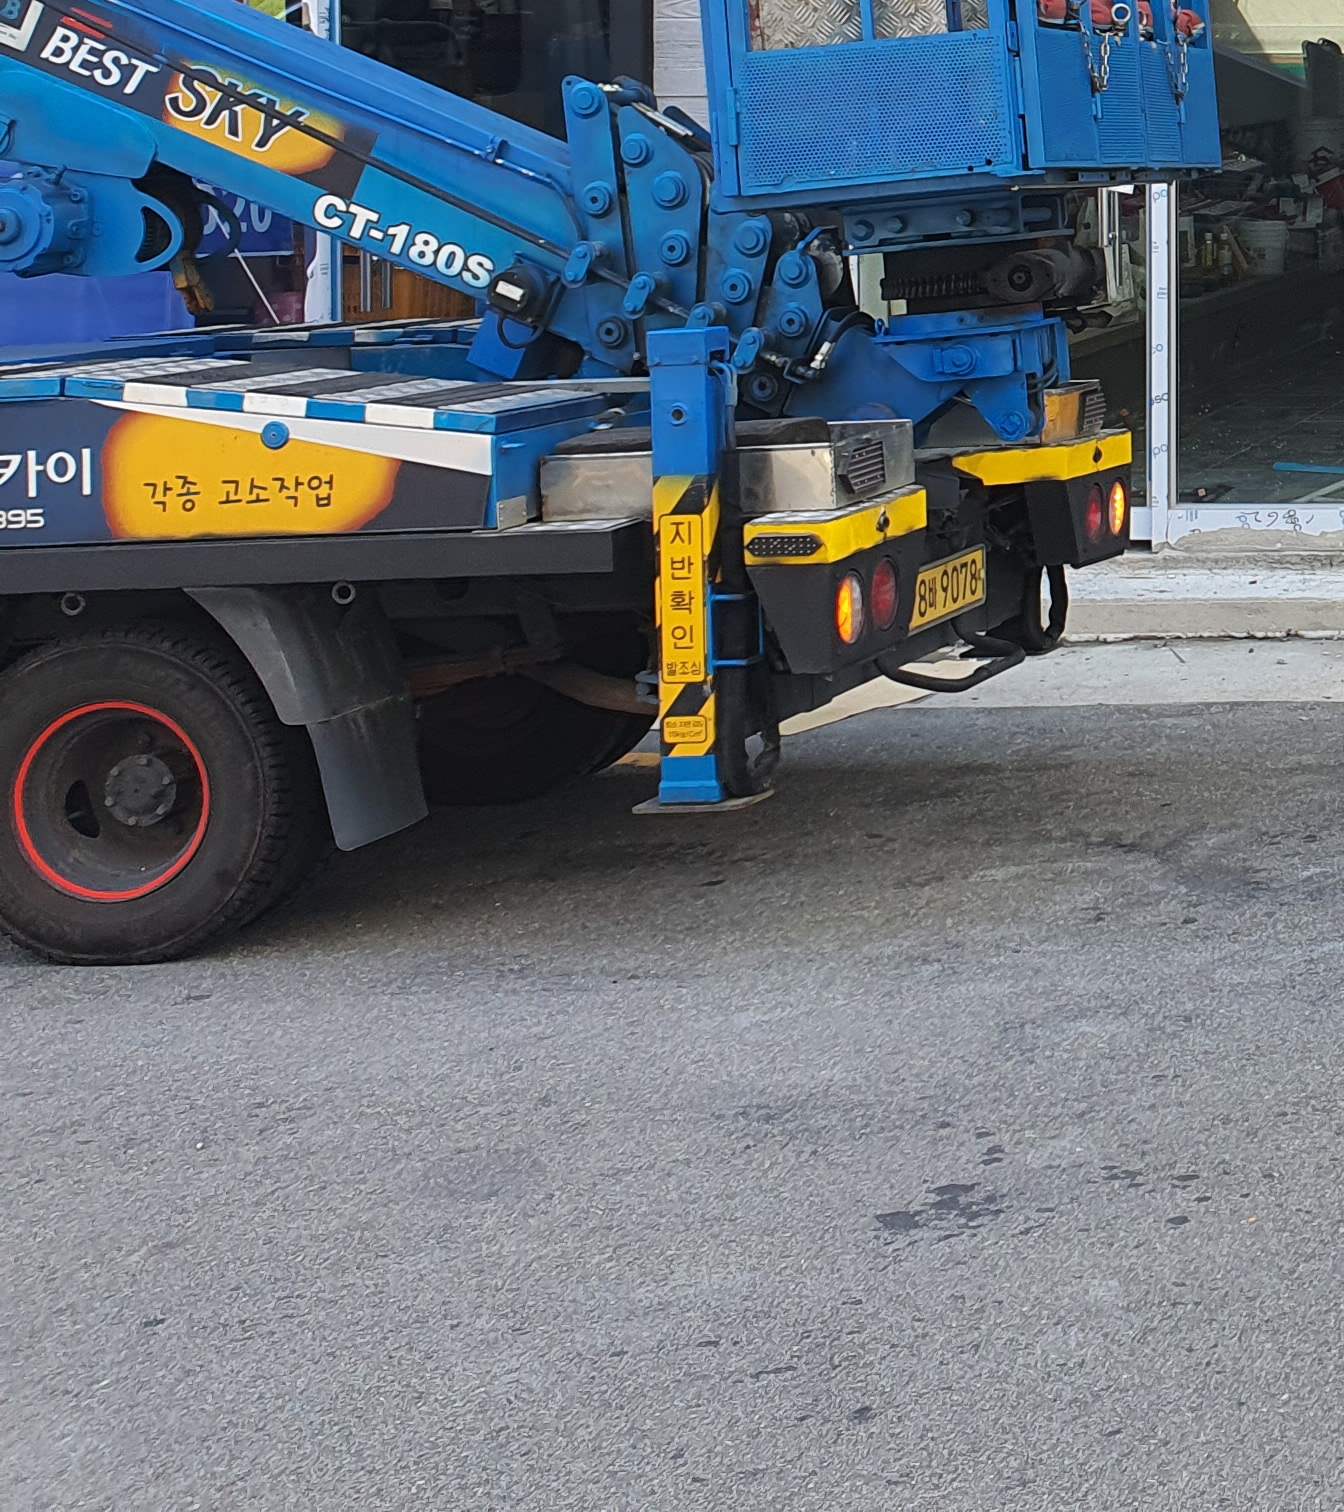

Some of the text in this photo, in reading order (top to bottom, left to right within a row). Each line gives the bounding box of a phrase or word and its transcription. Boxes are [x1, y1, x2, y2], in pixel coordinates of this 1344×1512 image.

[40, 25, 306, 155] BEST SKY
[310, 193, 495, 289] CT-180S
[143, 473, 335, 513] 각종 고소작업
[669, 520, 696, 651] 지반확인
[940, 558, 978, 609] 9078
[665, 660, 702, 677] 발조심
